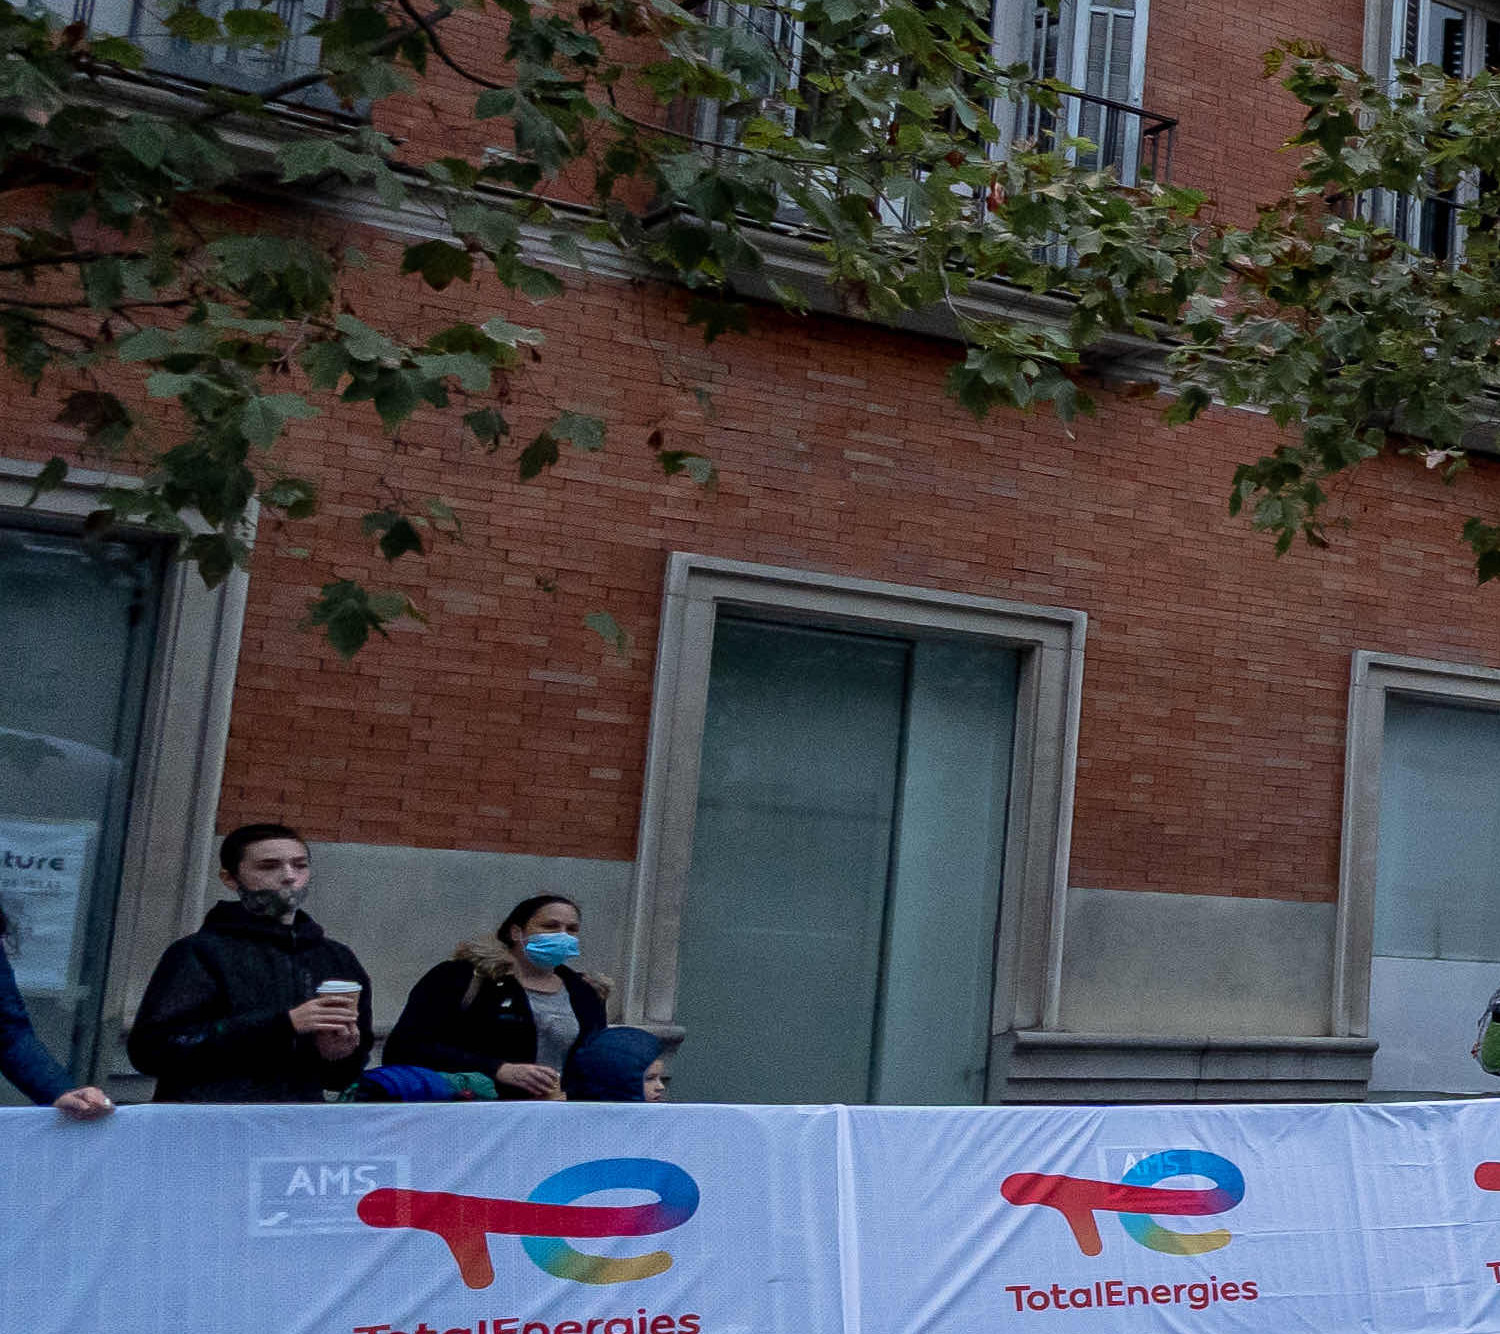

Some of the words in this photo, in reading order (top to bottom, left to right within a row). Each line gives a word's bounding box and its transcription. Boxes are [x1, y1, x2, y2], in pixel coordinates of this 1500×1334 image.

[4, 849, 65, 871] ture
[287, 1166, 378, 1196] AMS
[1006, 1275, 1259, 1312] TotalEnergies
